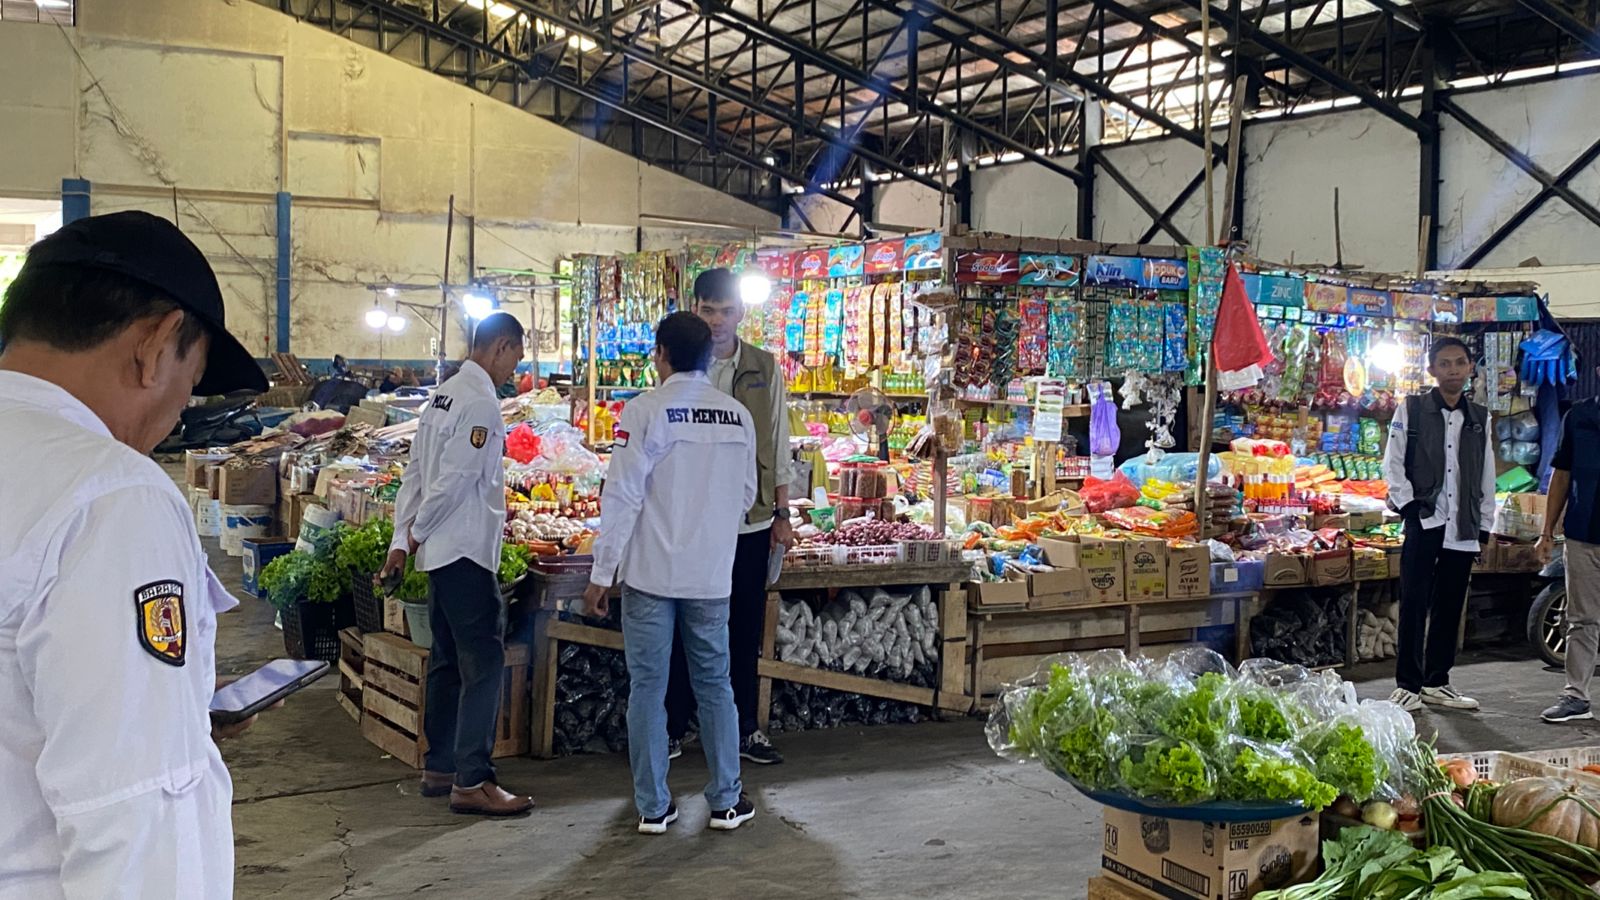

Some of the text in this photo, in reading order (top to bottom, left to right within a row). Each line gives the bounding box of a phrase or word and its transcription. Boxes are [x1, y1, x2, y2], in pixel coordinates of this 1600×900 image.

[1096, 263, 1122, 276] Klin
[1271, 286, 1292, 299] ZINC
[1507, 304, 1527, 315] ZINC
[692, 408, 743, 426] MENYALA
[1231, 822, 1270, 836] 65590059
[1106, 825, 1118, 847] 10
[1229, 839, 1249, 851] LIME
[1230, 872, 1246, 892] 10
